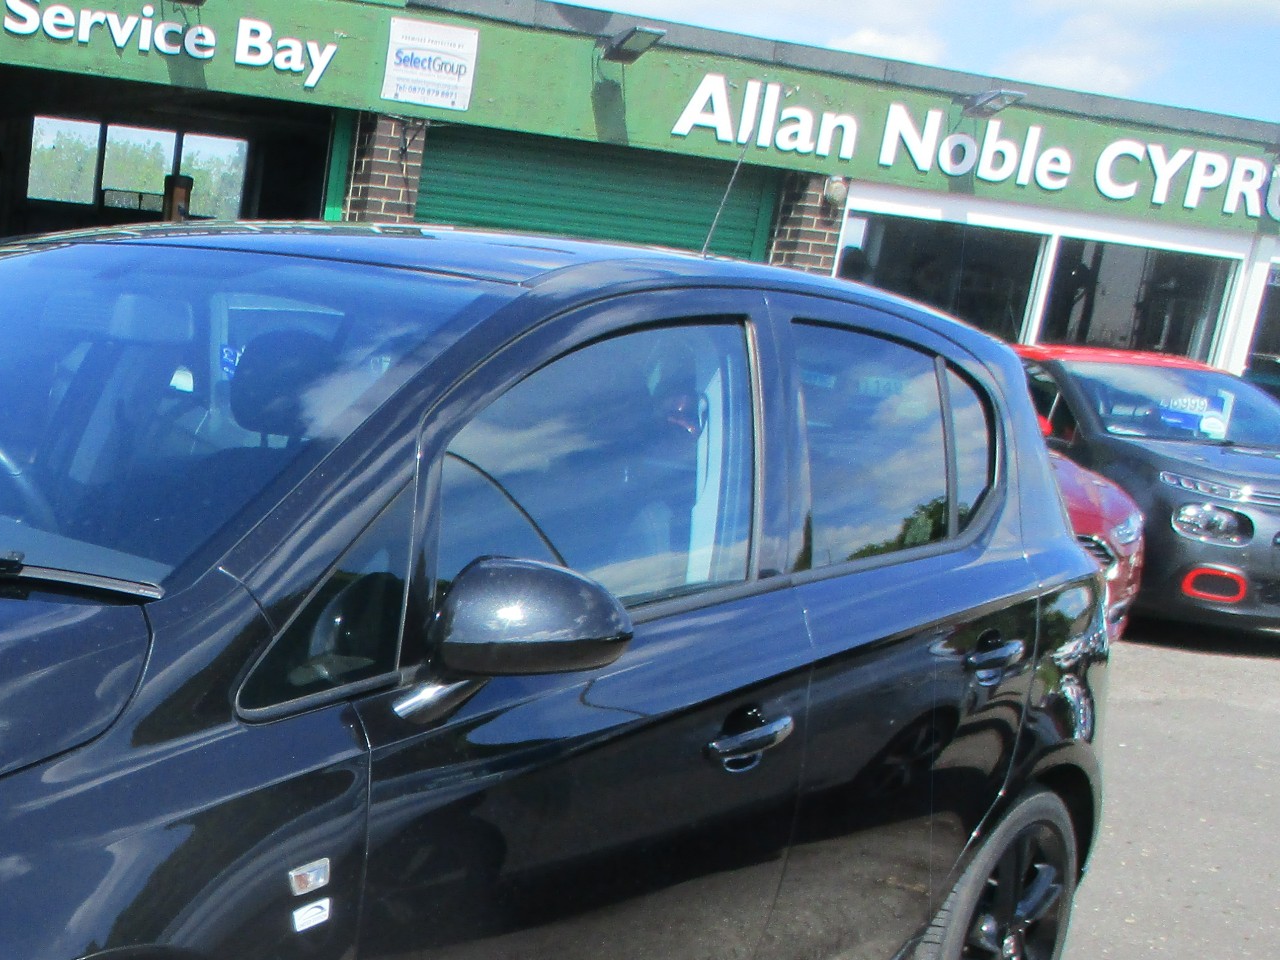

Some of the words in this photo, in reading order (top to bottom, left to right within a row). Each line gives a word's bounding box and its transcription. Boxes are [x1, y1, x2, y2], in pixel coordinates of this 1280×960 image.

[4, 0, 216, 60] Service
[234, 18, 338, 89] Bay
[393, 47, 467, 81] SelectGroup
[671, 73, 857, 161] Allan
[878, 103, 1072, 192] Noble
